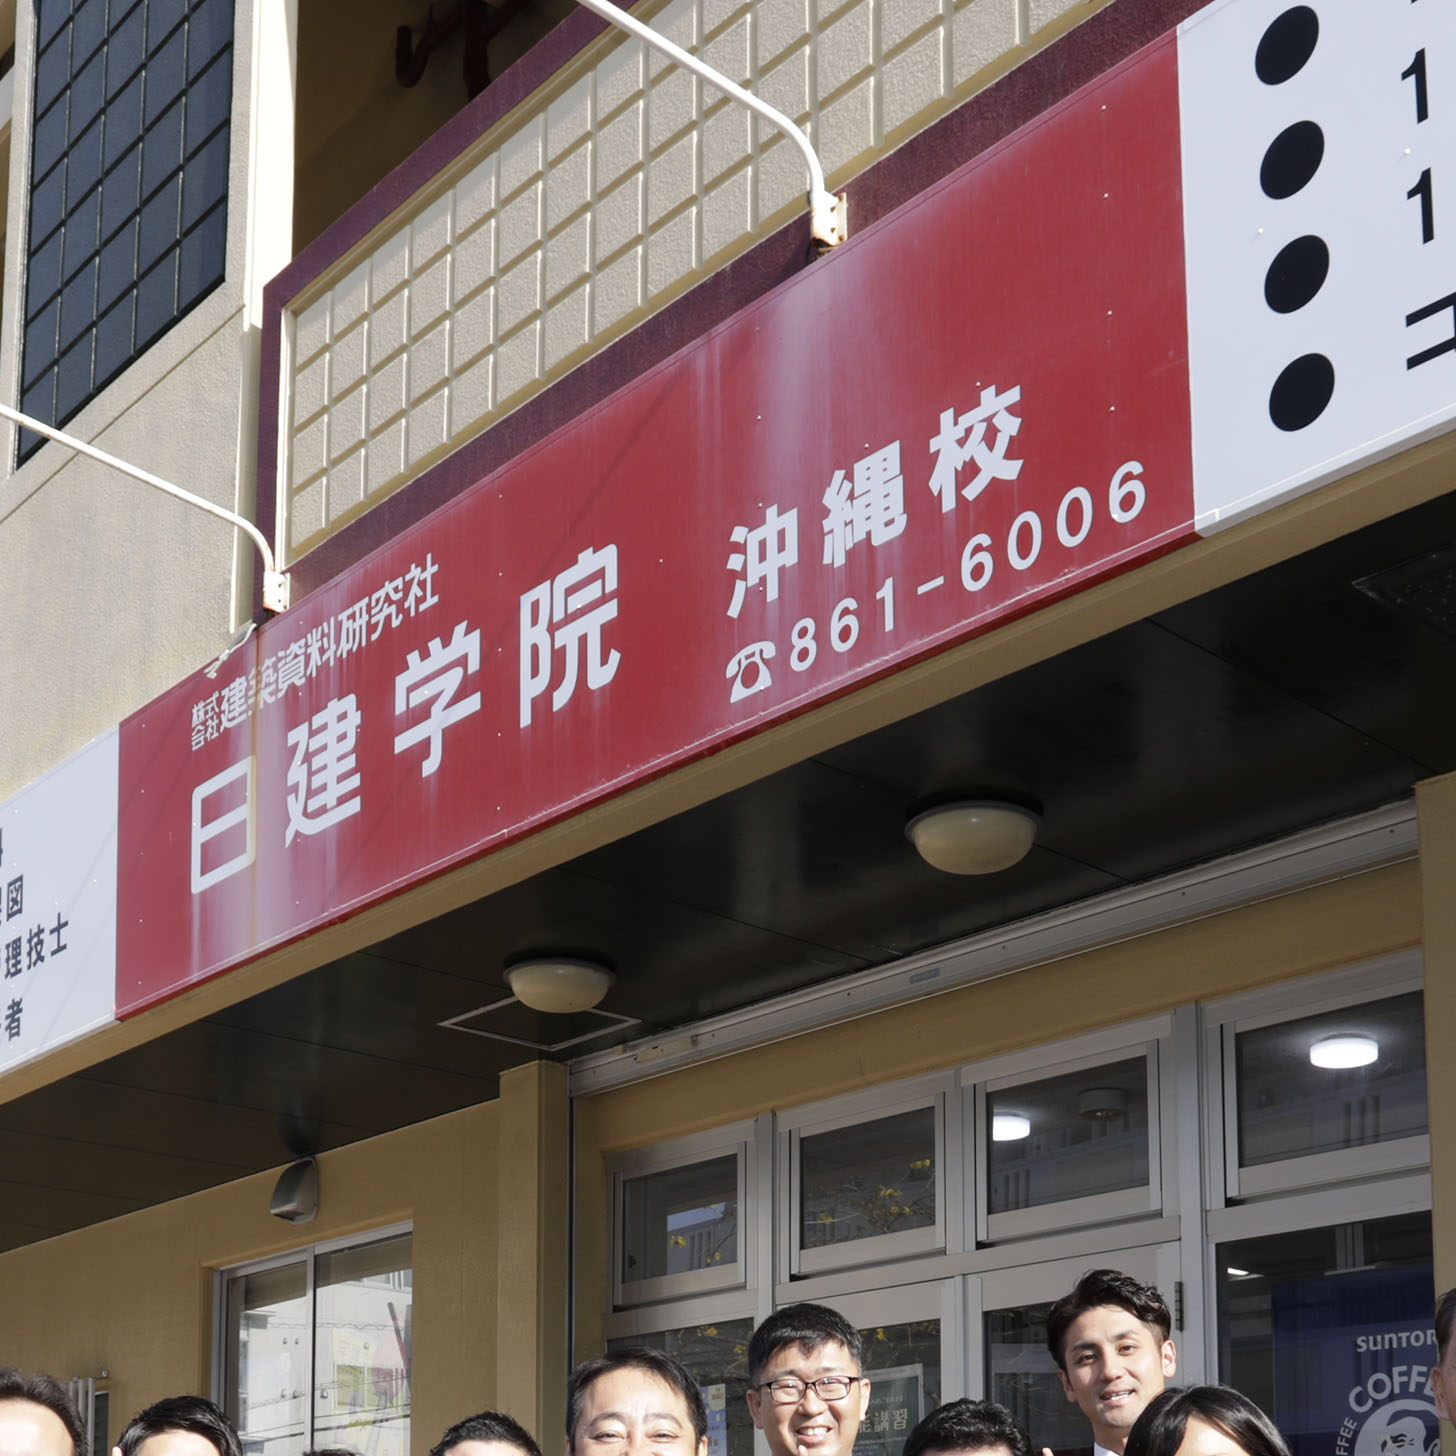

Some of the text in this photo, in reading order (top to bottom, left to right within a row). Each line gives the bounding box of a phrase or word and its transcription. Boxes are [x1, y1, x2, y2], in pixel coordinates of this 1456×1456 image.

[190, 384, 1023, 895] 日建学院 沖縄校
[789, 460, 1146, 674] 861-6006
